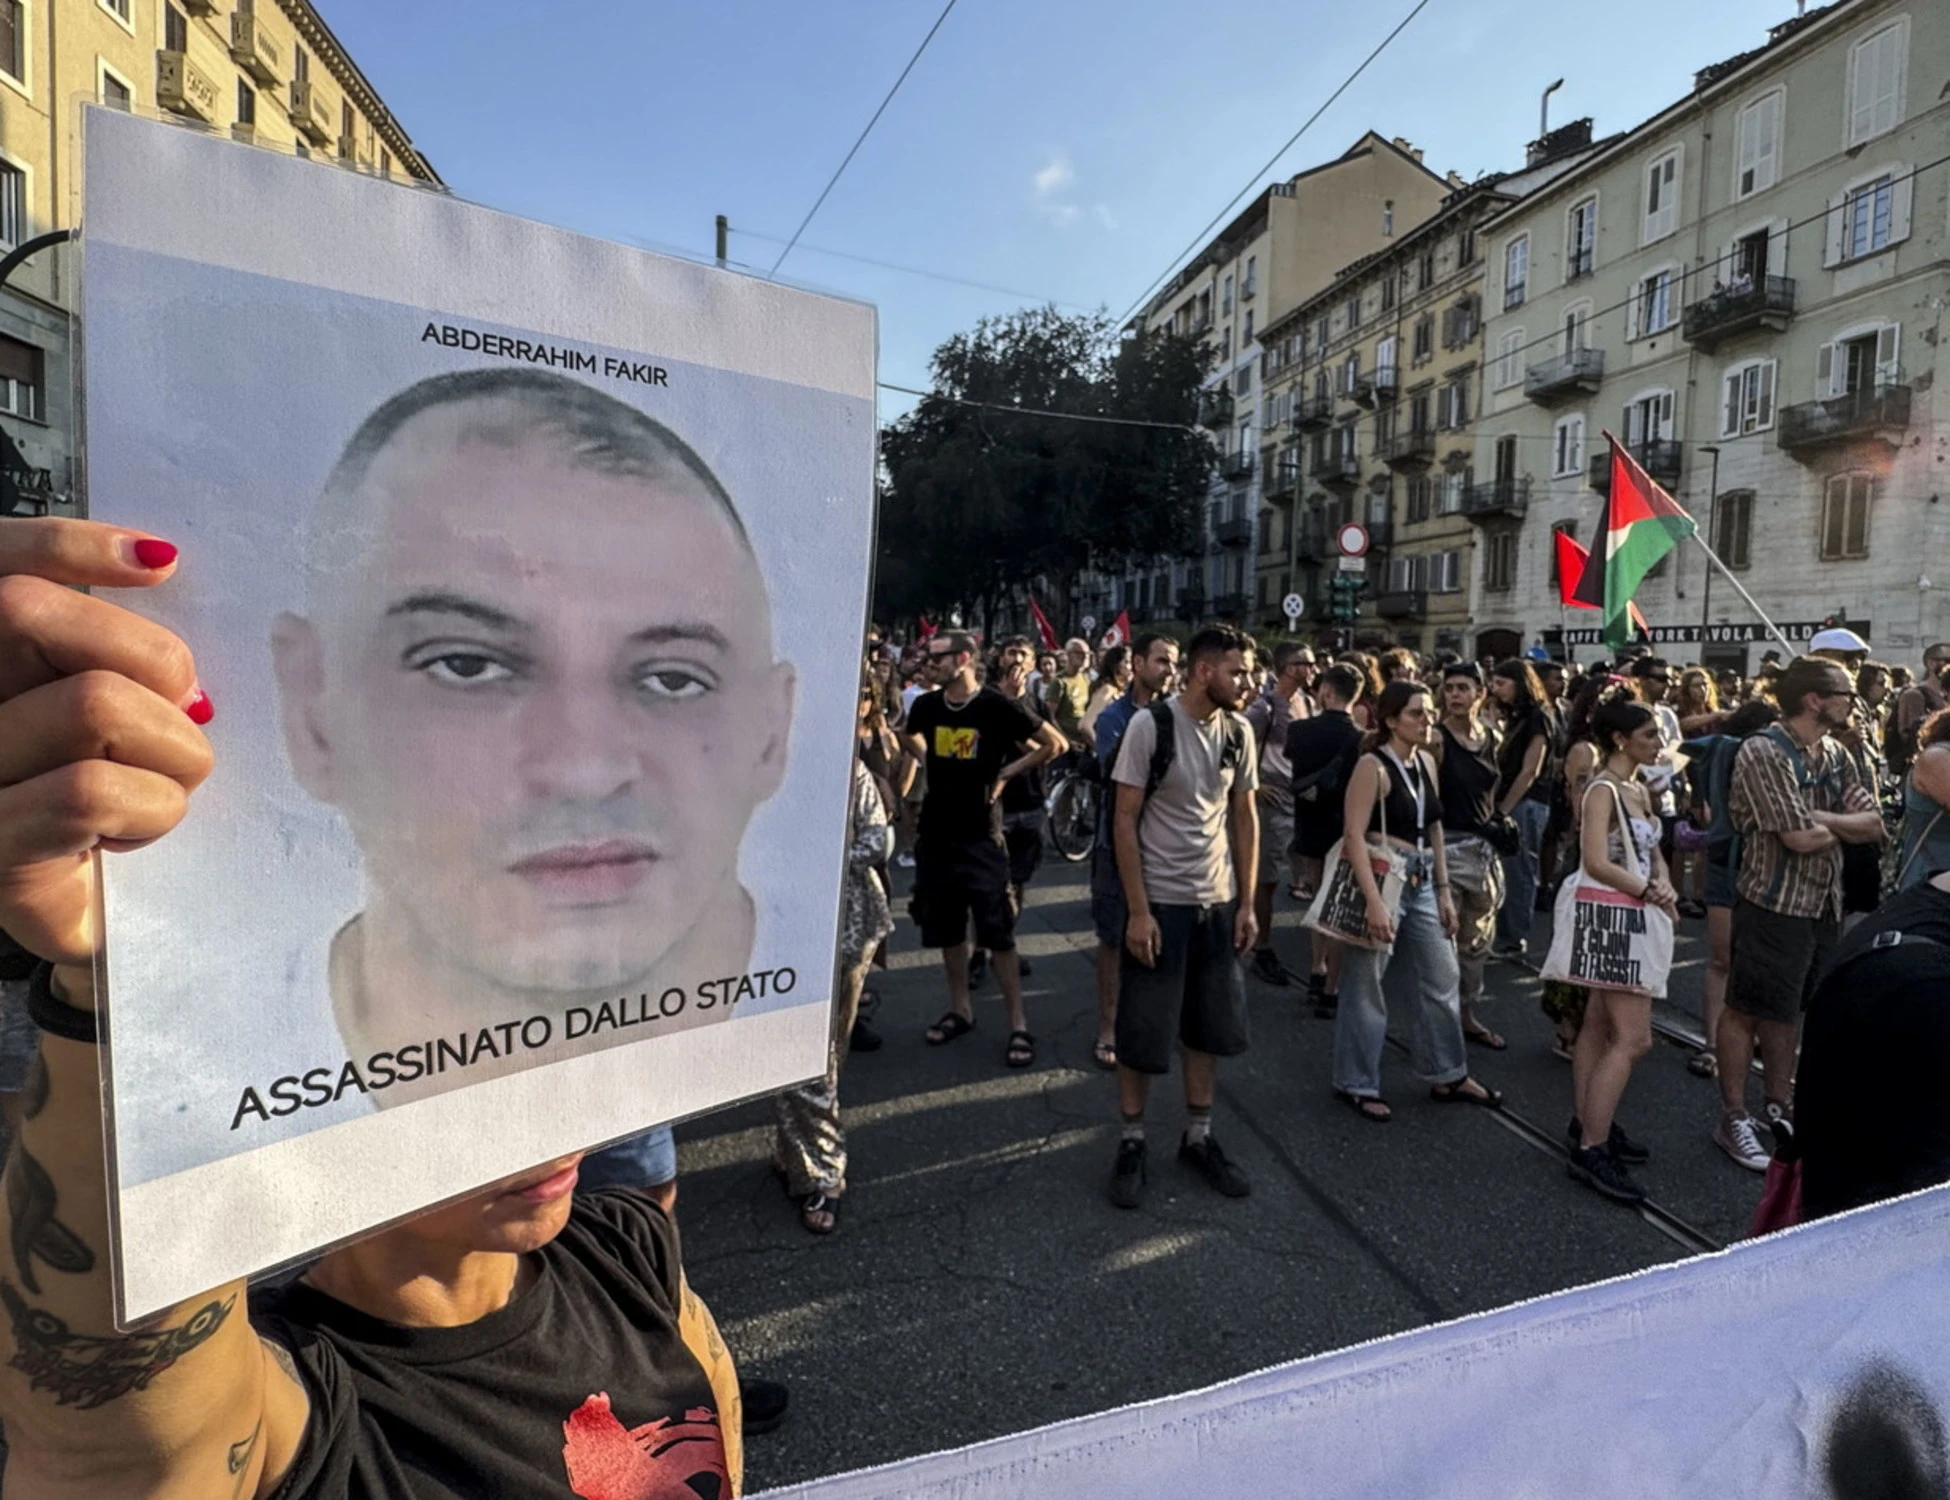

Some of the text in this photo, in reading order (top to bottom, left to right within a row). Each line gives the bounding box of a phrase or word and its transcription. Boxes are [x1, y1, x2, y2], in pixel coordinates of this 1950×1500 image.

[421, 322, 668, 387] ABDERRAHIM FAKIR
[1764, 625, 1825, 641] CALD
[935, 726, 981, 760] MTV
[230, 966, 797, 1130] ASSASSINATO DALLO STATO
